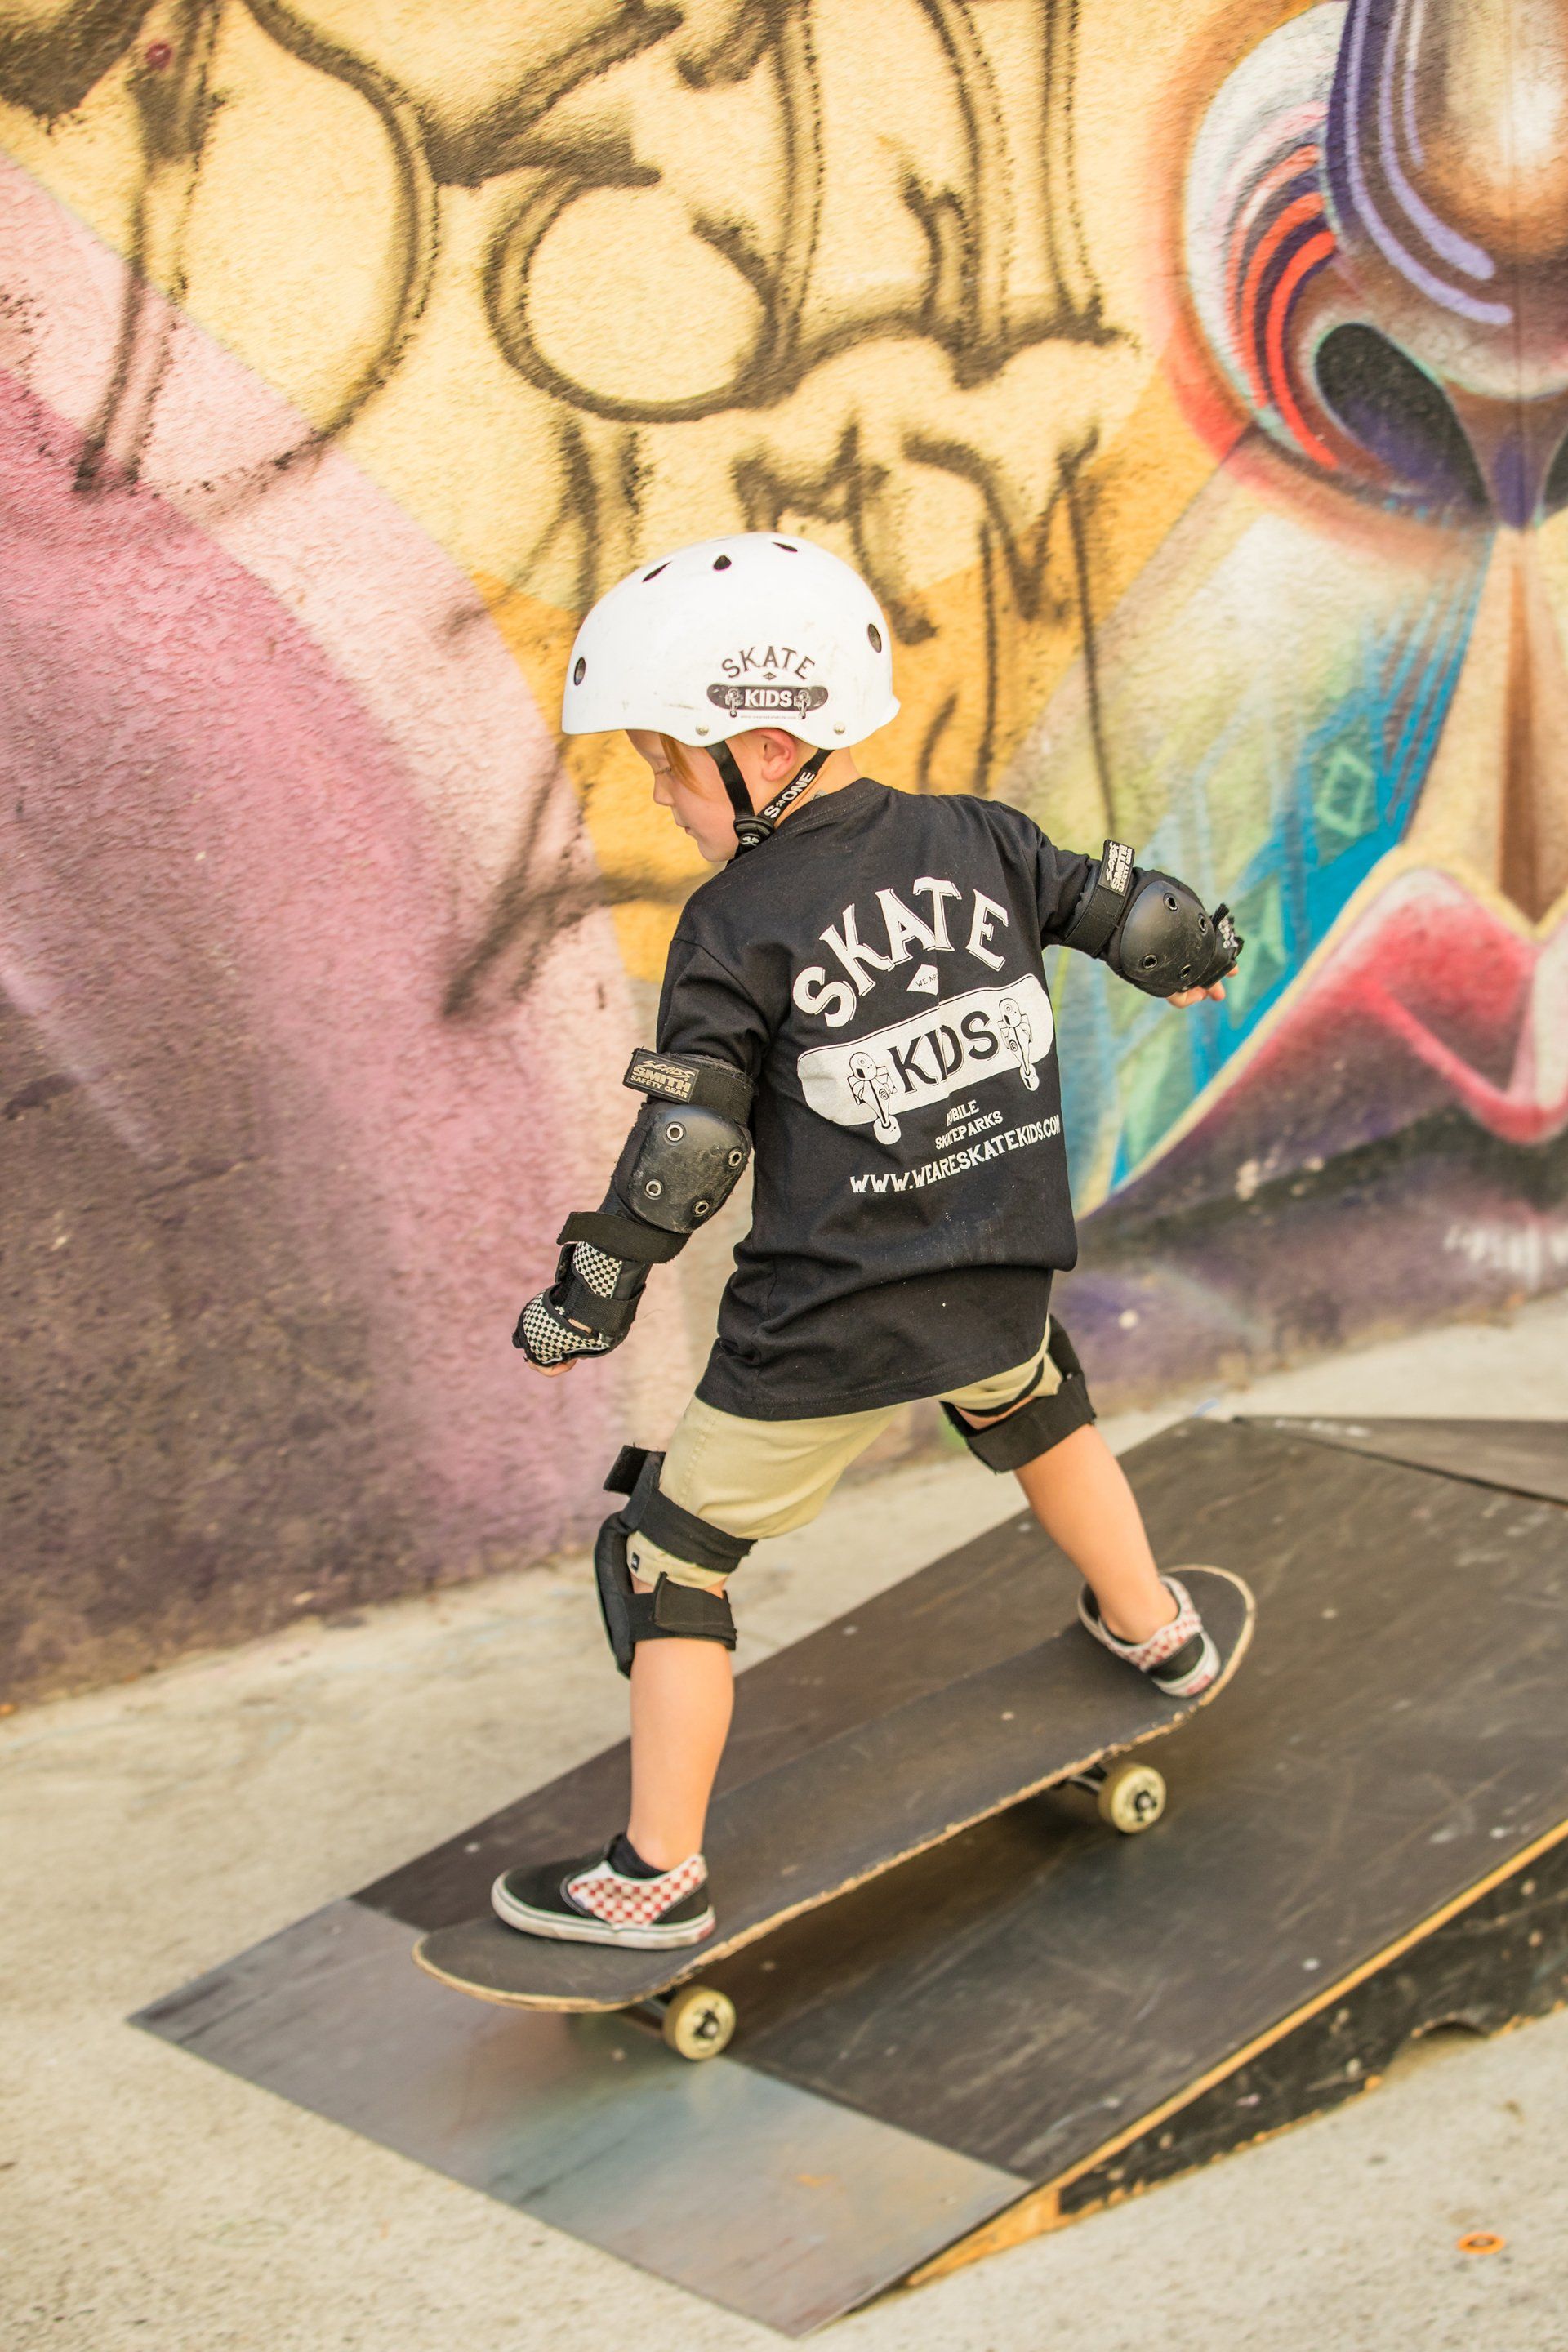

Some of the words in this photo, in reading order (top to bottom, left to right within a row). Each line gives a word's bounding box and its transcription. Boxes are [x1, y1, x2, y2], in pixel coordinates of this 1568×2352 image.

[721, 645, 815, 680] SKATE
[744, 688, 793, 708] KIDS
[792, 876, 1009, 1027] SKATE
[887, 1011, 1000, 1095] KIDS
[630, 1074, 664, 1089] SAFETY
[664, 1085, 688, 1098] GEAR
[632, 1066, 692, 1093] SMITH
[849, 1114, 1061, 1193] WWW.WEARESKATEKIDS.COM
